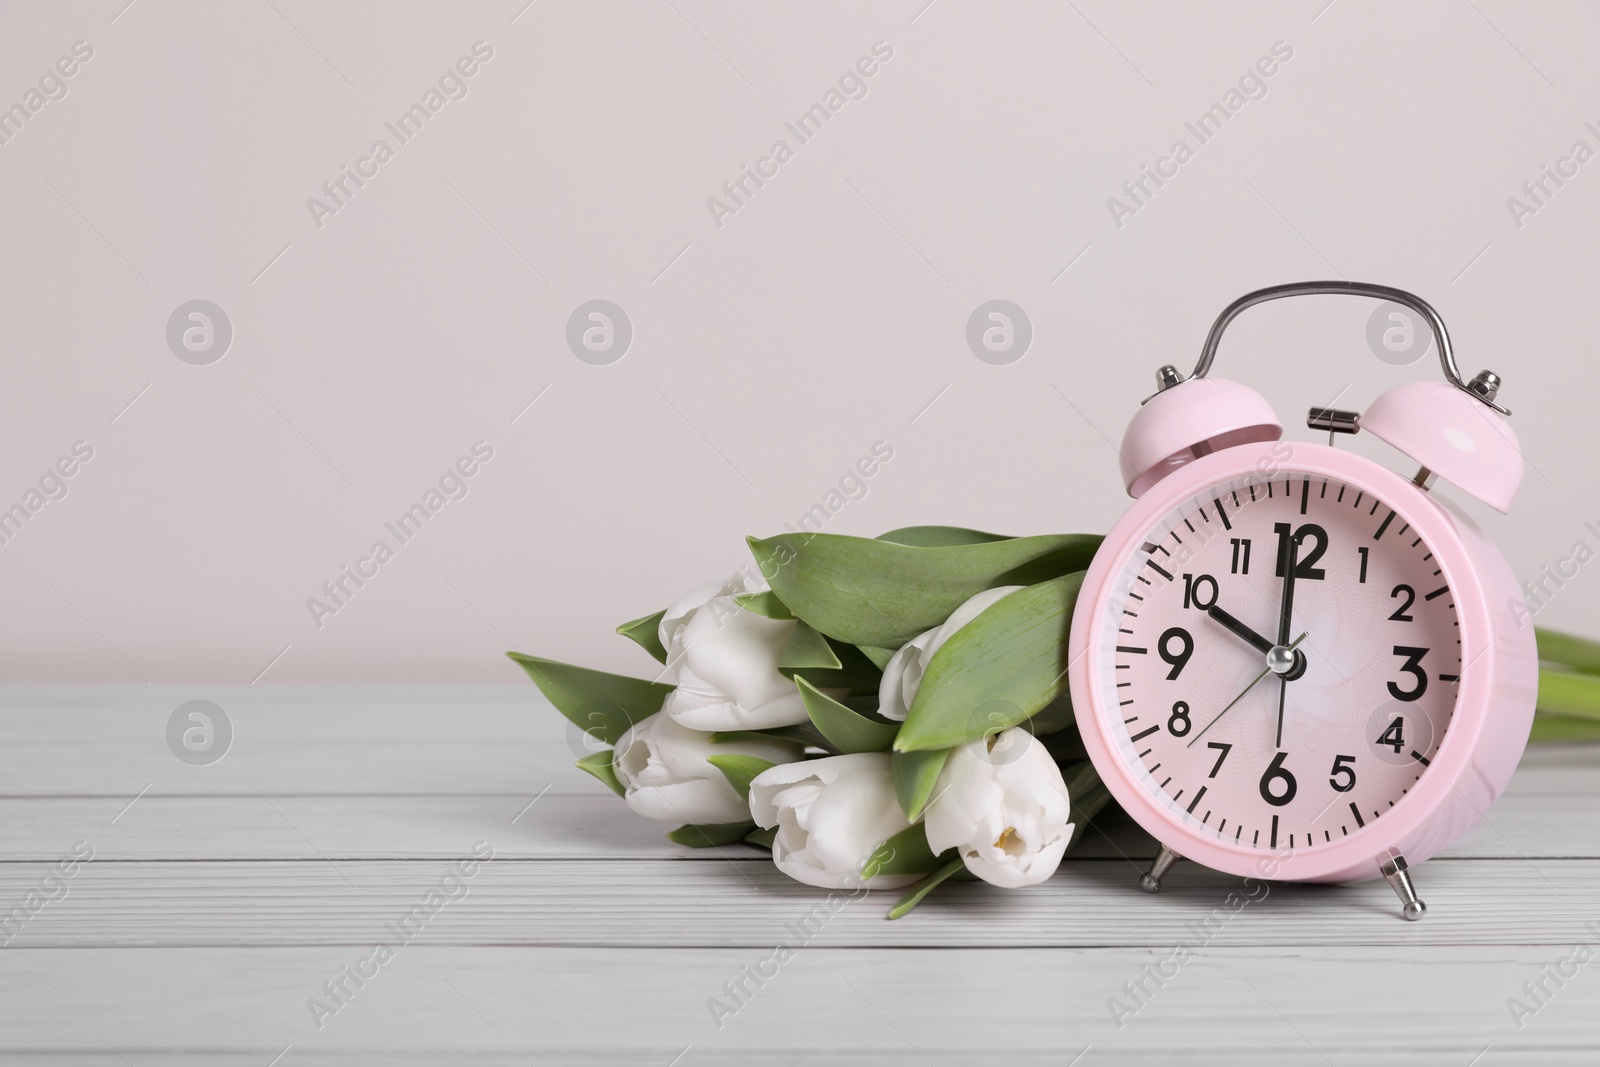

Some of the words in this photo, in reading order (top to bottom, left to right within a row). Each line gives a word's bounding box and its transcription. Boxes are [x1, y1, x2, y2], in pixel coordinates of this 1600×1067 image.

[1230, 538, 1252, 575] 11
[1274, 522, 1328, 580] 12
[1358, 547, 1369, 583] 1
[1183, 574, 1219, 610] 10
[1388, 584, 1415, 622] 2
[1158, 627, 1194, 681] 9
[1387, 646, 1430, 702] 3
[1167, 701, 1192, 738] 8
[1376, 717, 1405, 753] 4
[1208, 742, 1232, 779] 7
[1260, 752, 1297, 806] 6
[1329, 755, 1357, 792] 5
